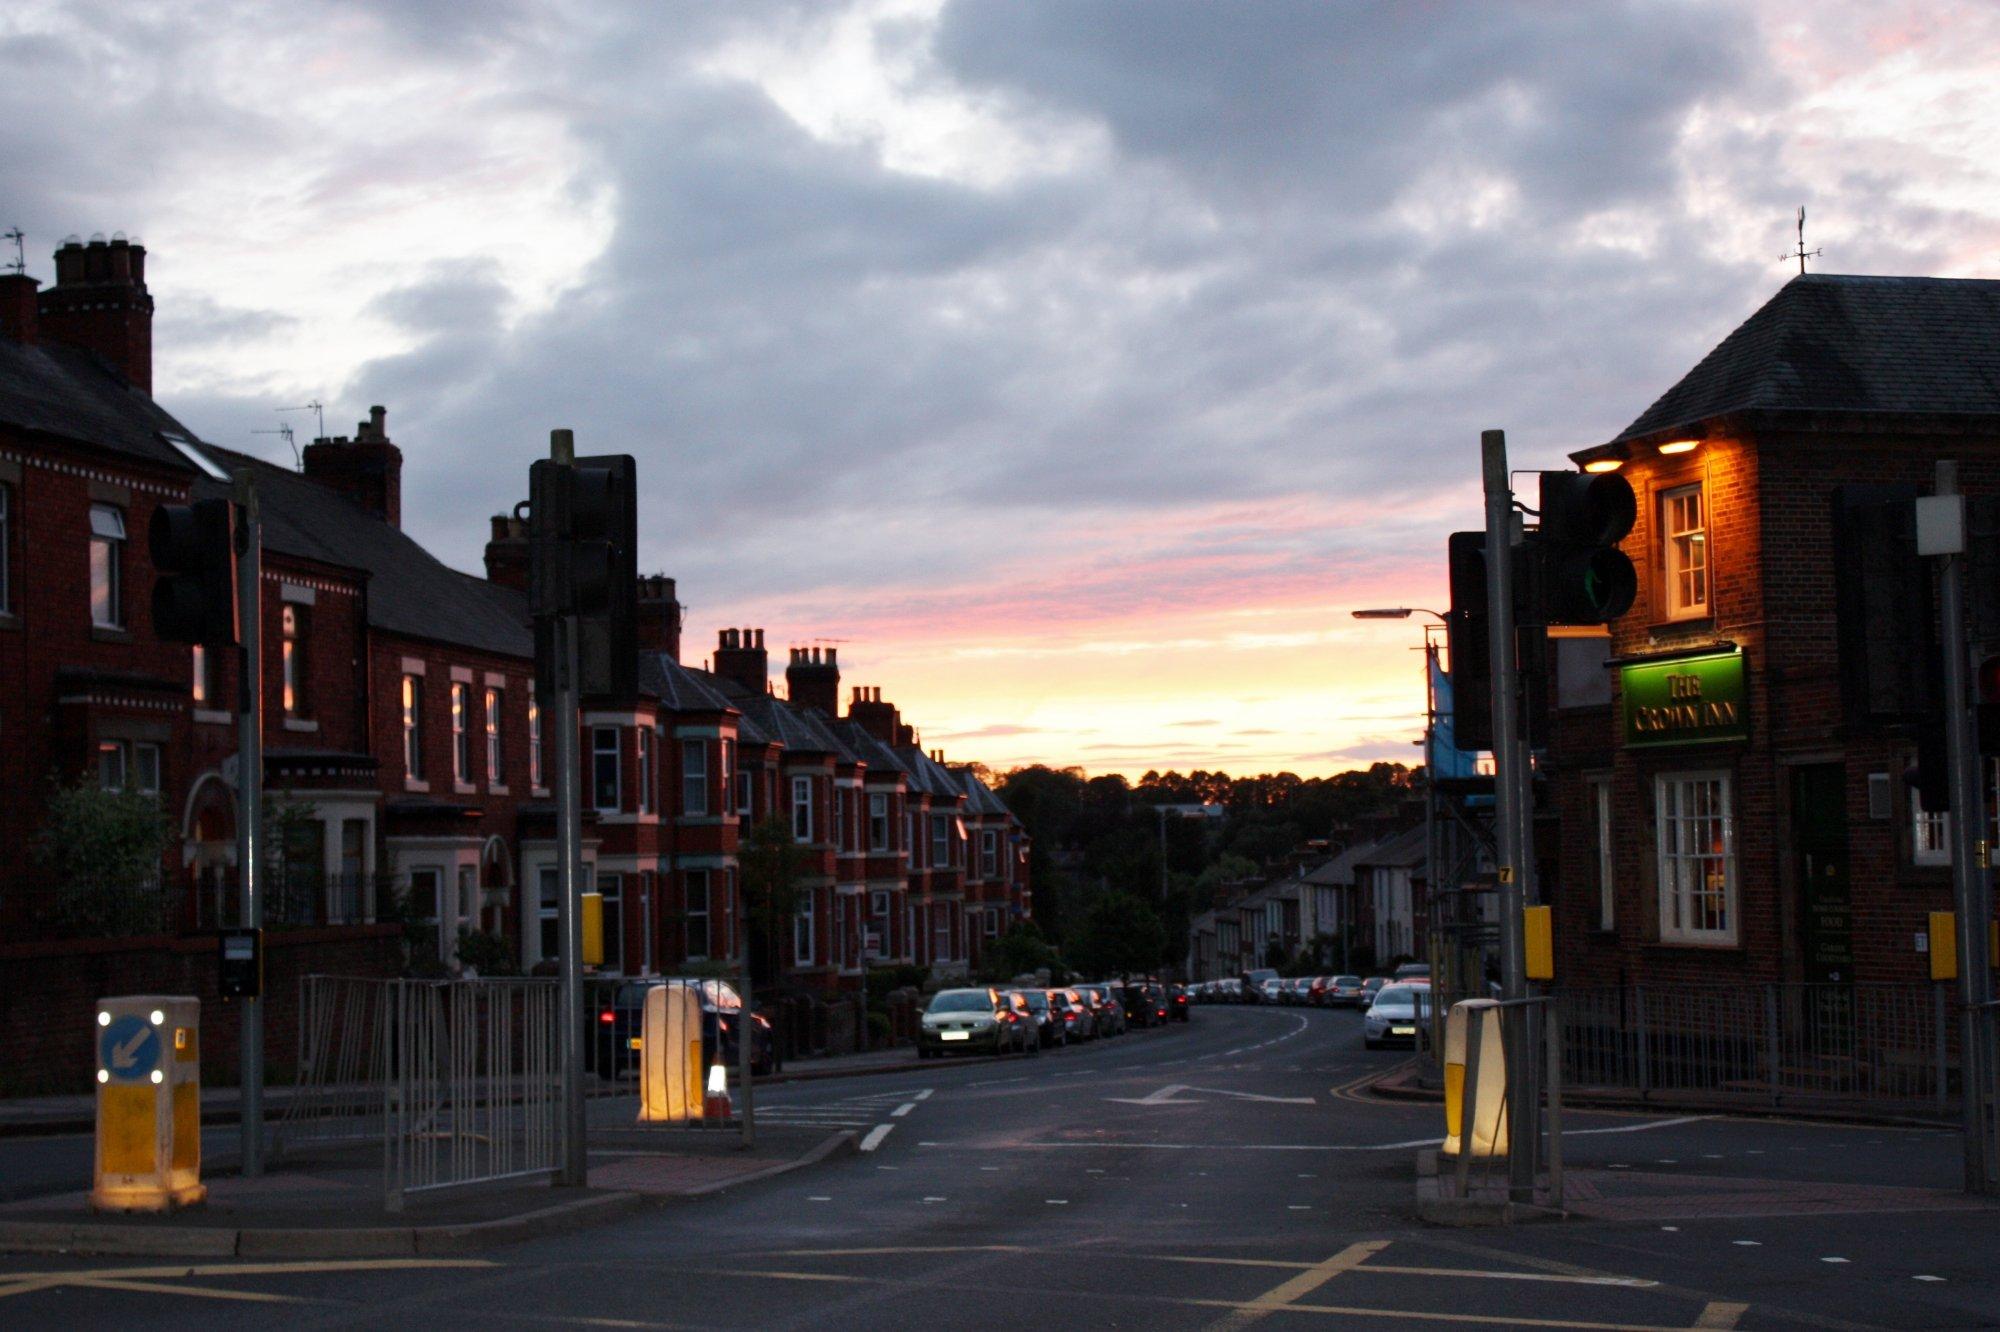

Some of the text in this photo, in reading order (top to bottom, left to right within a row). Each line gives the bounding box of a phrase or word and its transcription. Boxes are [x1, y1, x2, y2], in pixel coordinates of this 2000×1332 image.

[1667, 675, 1702, 698] THE
[1634, 701, 1738, 733] CROWN INN
[1501, 868, 1510, 881] 7
